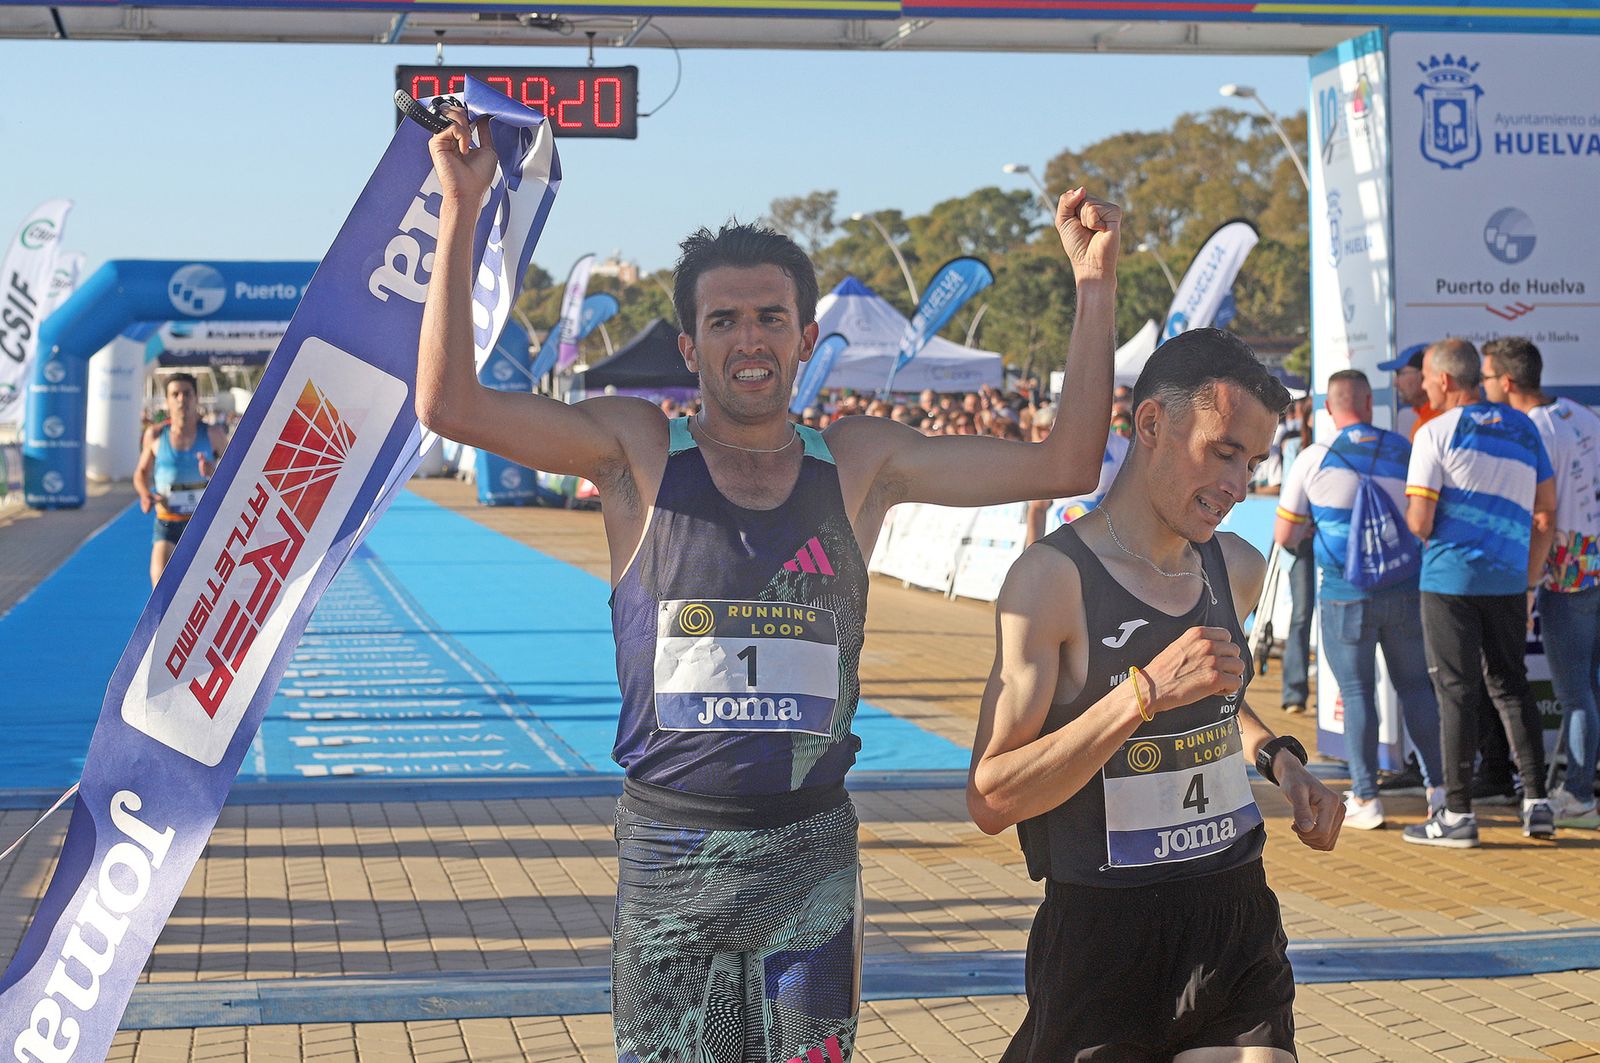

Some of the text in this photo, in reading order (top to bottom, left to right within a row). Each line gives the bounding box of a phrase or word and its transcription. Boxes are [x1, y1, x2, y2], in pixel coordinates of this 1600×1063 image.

[1494, 112, 1586, 128] Ayuntamiento
[1495, 132, 1600, 155] HUELVA
[234, 282, 297, 300] Puerto
[1436, 278, 1585, 294] Puerto de Huelva
[0, 271, 37, 363] CSIF
[165, 482, 270, 679] ATLETISMO
[188, 507, 305, 719] RFEA
[728, 605, 817, 622] RUNNING
[751, 623, 804, 637] LOOP
[736, 645, 757, 687] 1
[1174, 722, 1234, 751] RUNNING
[1194, 743, 1228, 764] LOOP
[1182, 773, 1209, 815] 4
